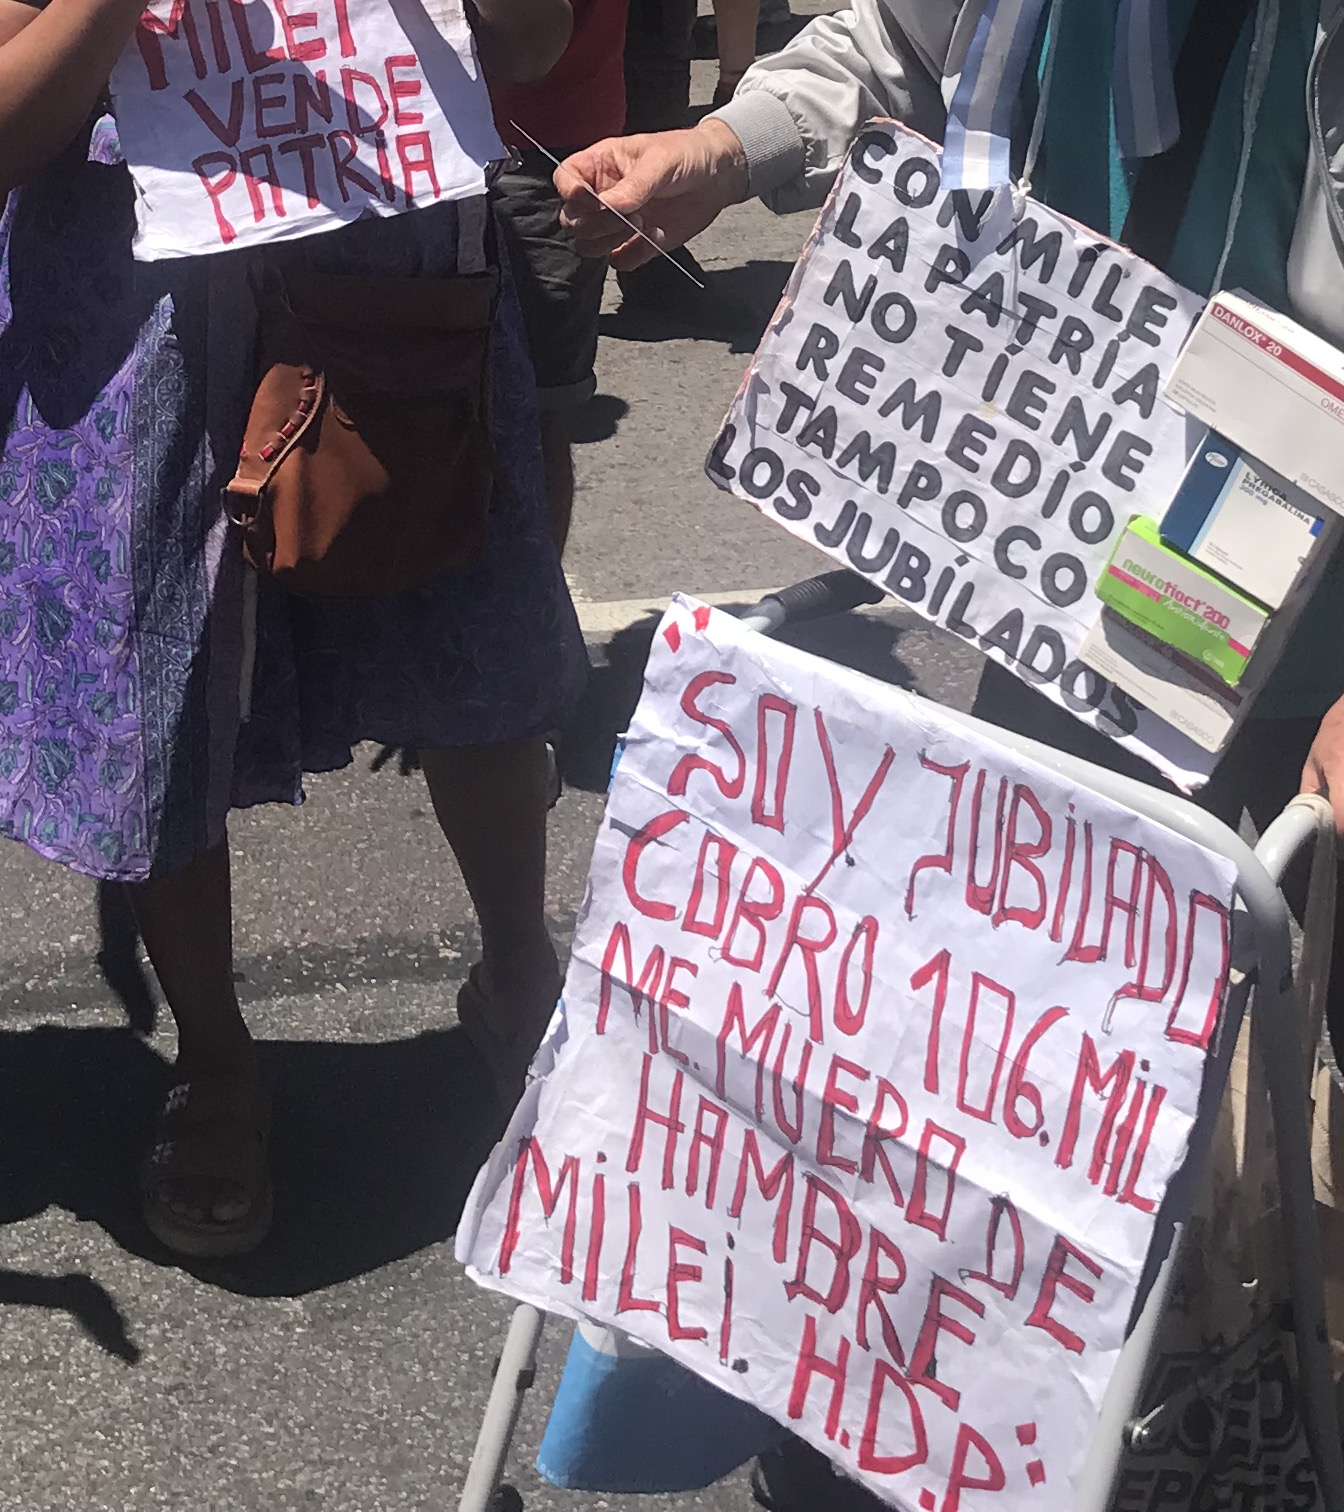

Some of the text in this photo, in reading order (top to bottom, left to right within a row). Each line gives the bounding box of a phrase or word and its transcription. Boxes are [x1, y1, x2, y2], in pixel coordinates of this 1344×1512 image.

[183, 54, 424, 148] VENDE
[834, 191, 911, 274] LA
[851, 128, 995, 242] CON
[822, 259, 917, 345] NO
[1265, 340, 1283, 357] 20
[704, 423, 821, 522] LOS
[775, 381, 1089, 608] TAMPOCO
[1241, 477, 1311, 525] PREGABALINA
[1202, 603, 1231, 630] 200
[622, 809, 879, 1044] COBRO
[625, 1051, 987, 1413] HAMBRE
[960, 1192, 1105, 1354] DE
